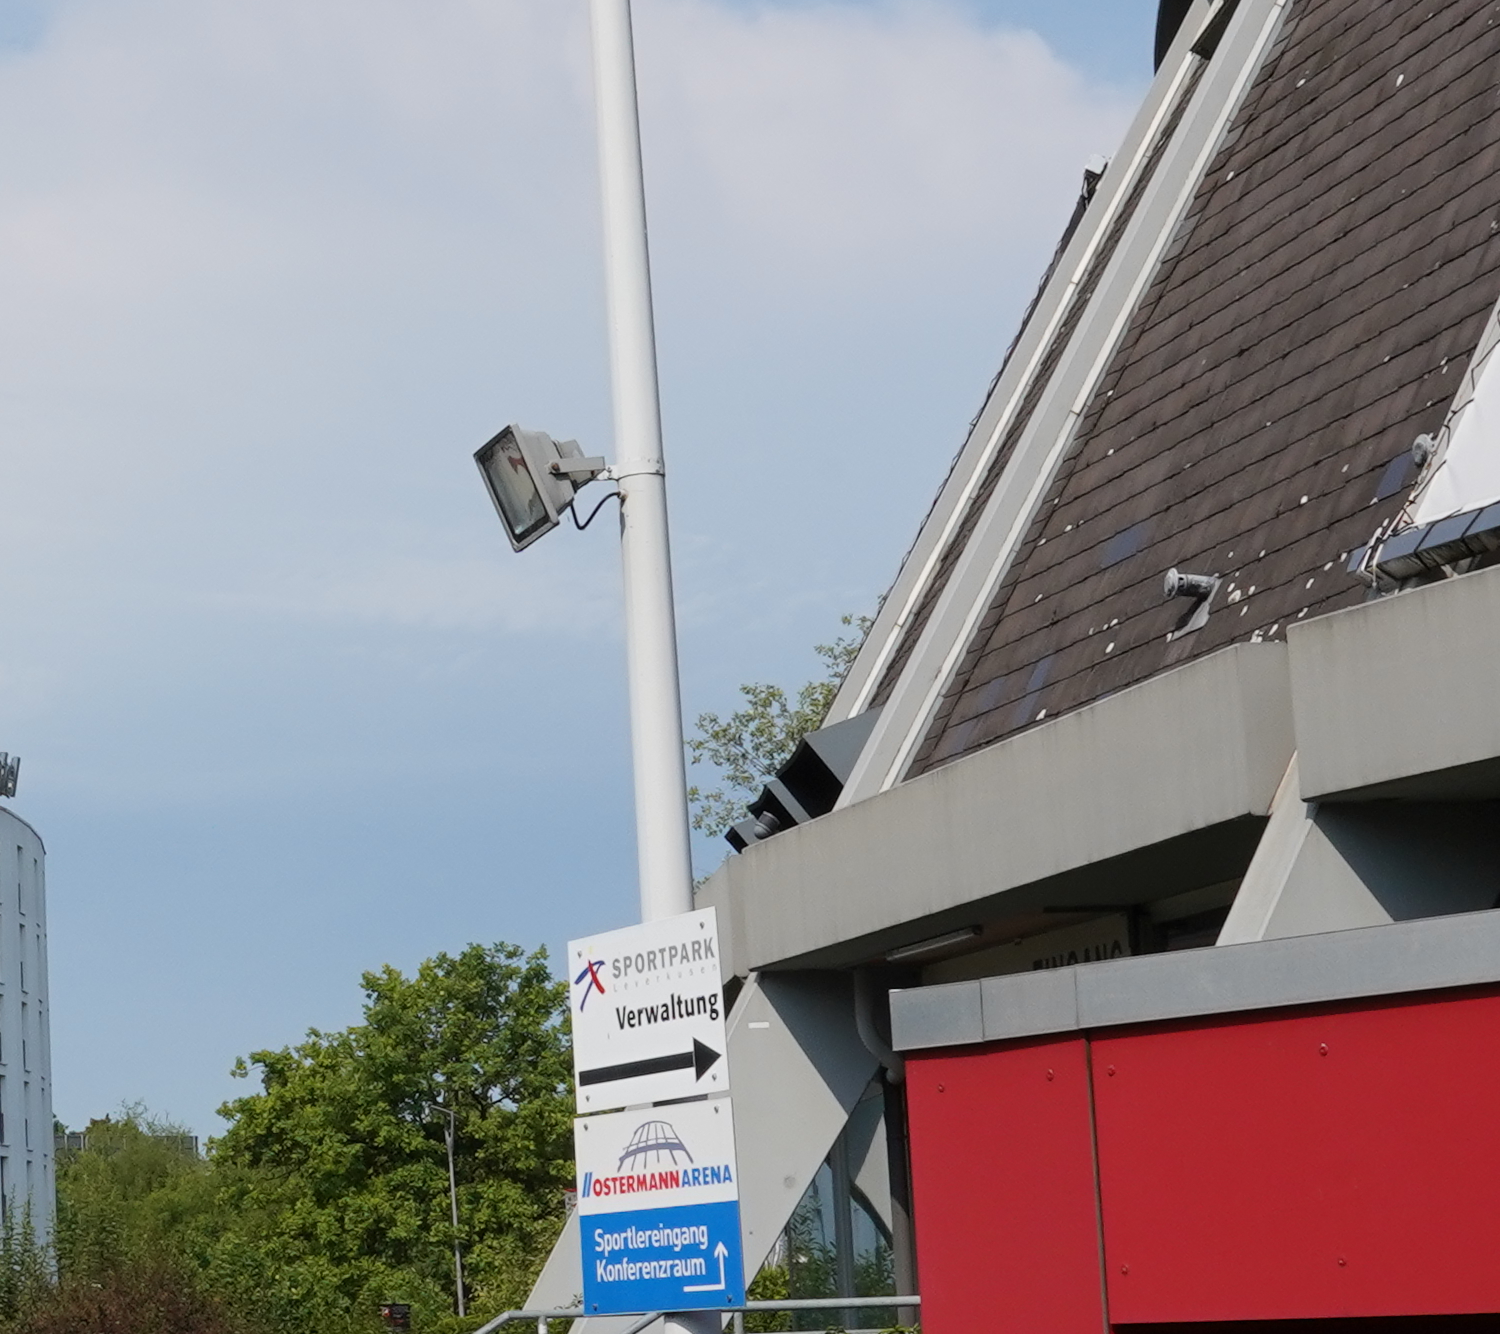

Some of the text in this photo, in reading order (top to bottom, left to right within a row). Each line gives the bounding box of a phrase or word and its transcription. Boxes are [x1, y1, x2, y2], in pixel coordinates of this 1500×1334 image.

[611, 936, 716, 979] SPORTPARK
[615, 991, 719, 1031] Verwaltung
[594, 1223, 708, 1253] Sportlereingang
[596, 1258, 706, 1283] Konferenzraum
